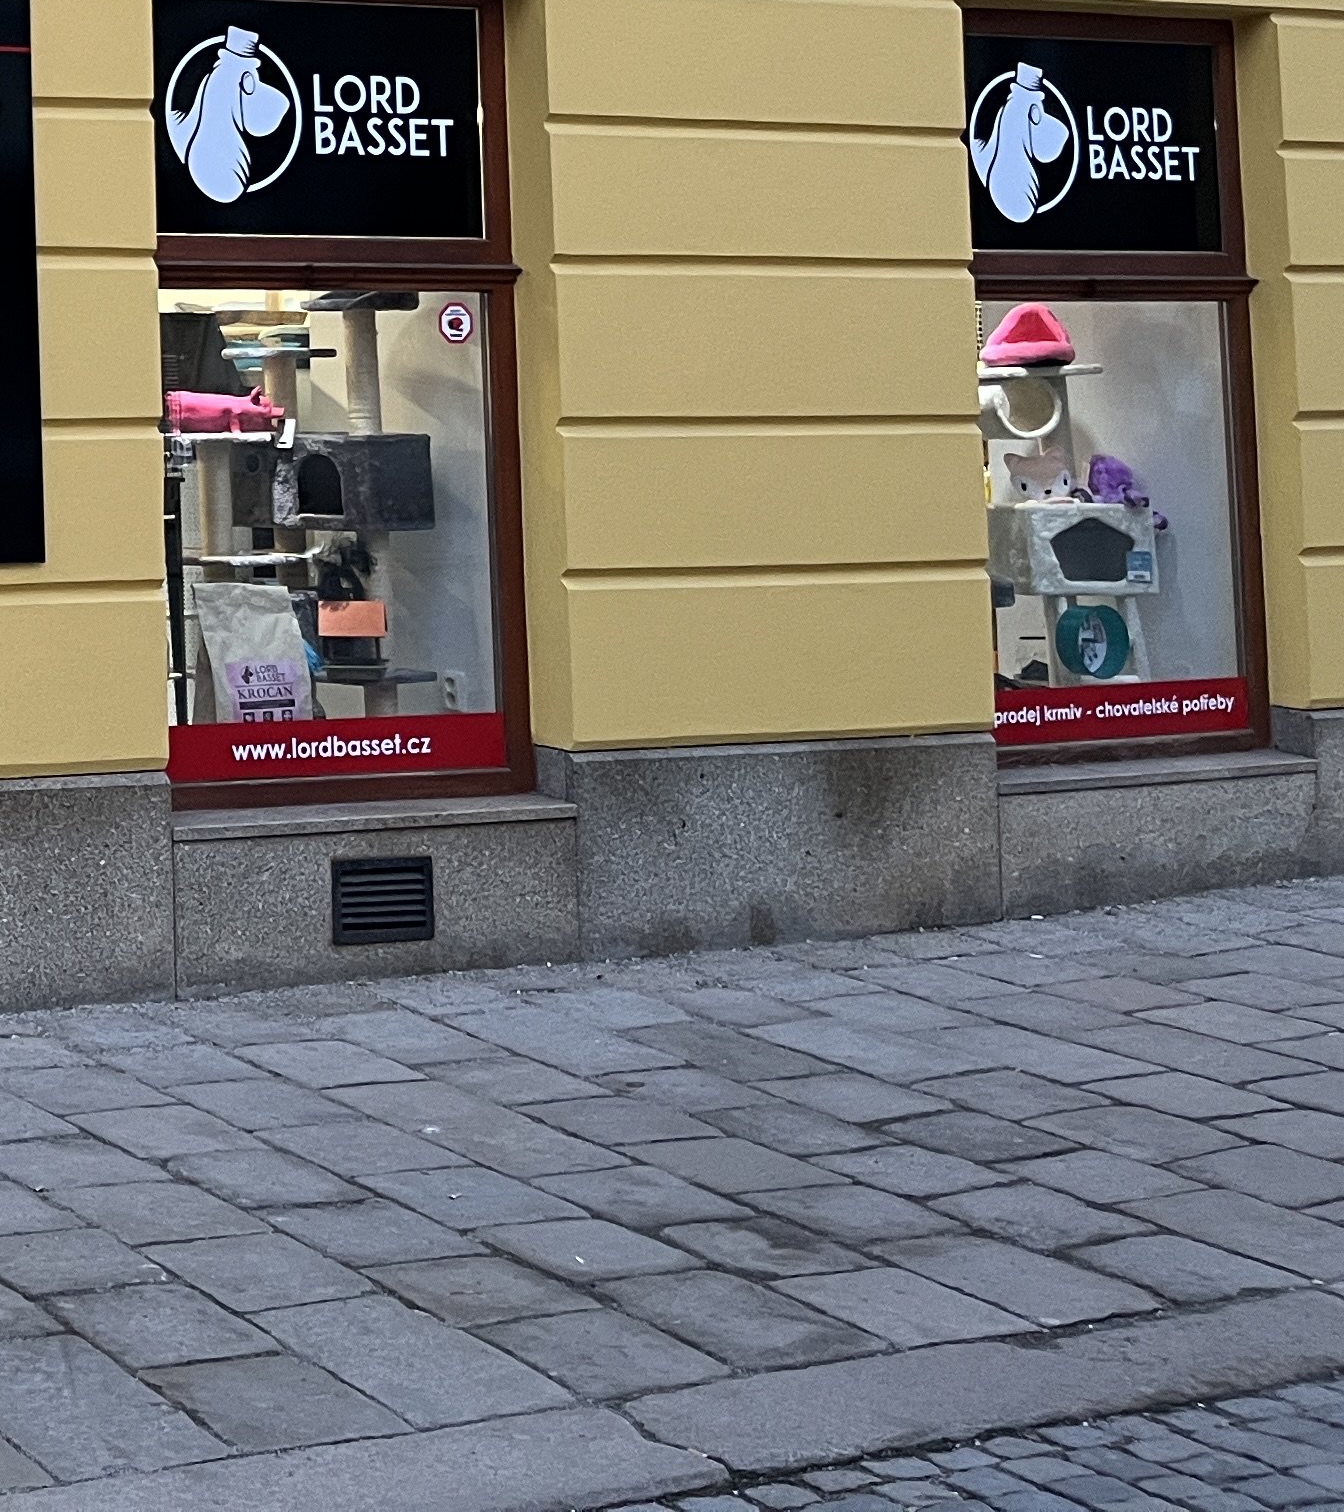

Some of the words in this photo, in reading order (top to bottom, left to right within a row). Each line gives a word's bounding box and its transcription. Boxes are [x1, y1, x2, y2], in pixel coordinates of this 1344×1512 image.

[313, 73, 420, 114] LORD
[314, 116, 454, 157] BASSET
[1086, 106, 1173, 143] LORD
[1089, 144, 1200, 181] BASSET
[255, 665, 278, 674] LORD
[257, 673, 286, 682] BASSET
[238, 686, 293, 700] KROCAN
[994, 706, 1041, 729] prodej
[1044, 704, 1082, 721] krmiv
[1096, 695, 1178, 718] chovatelské
[1183, 694, 1234, 715] potřeby
[232, 733, 431, 760] www.lordbasset.cz
